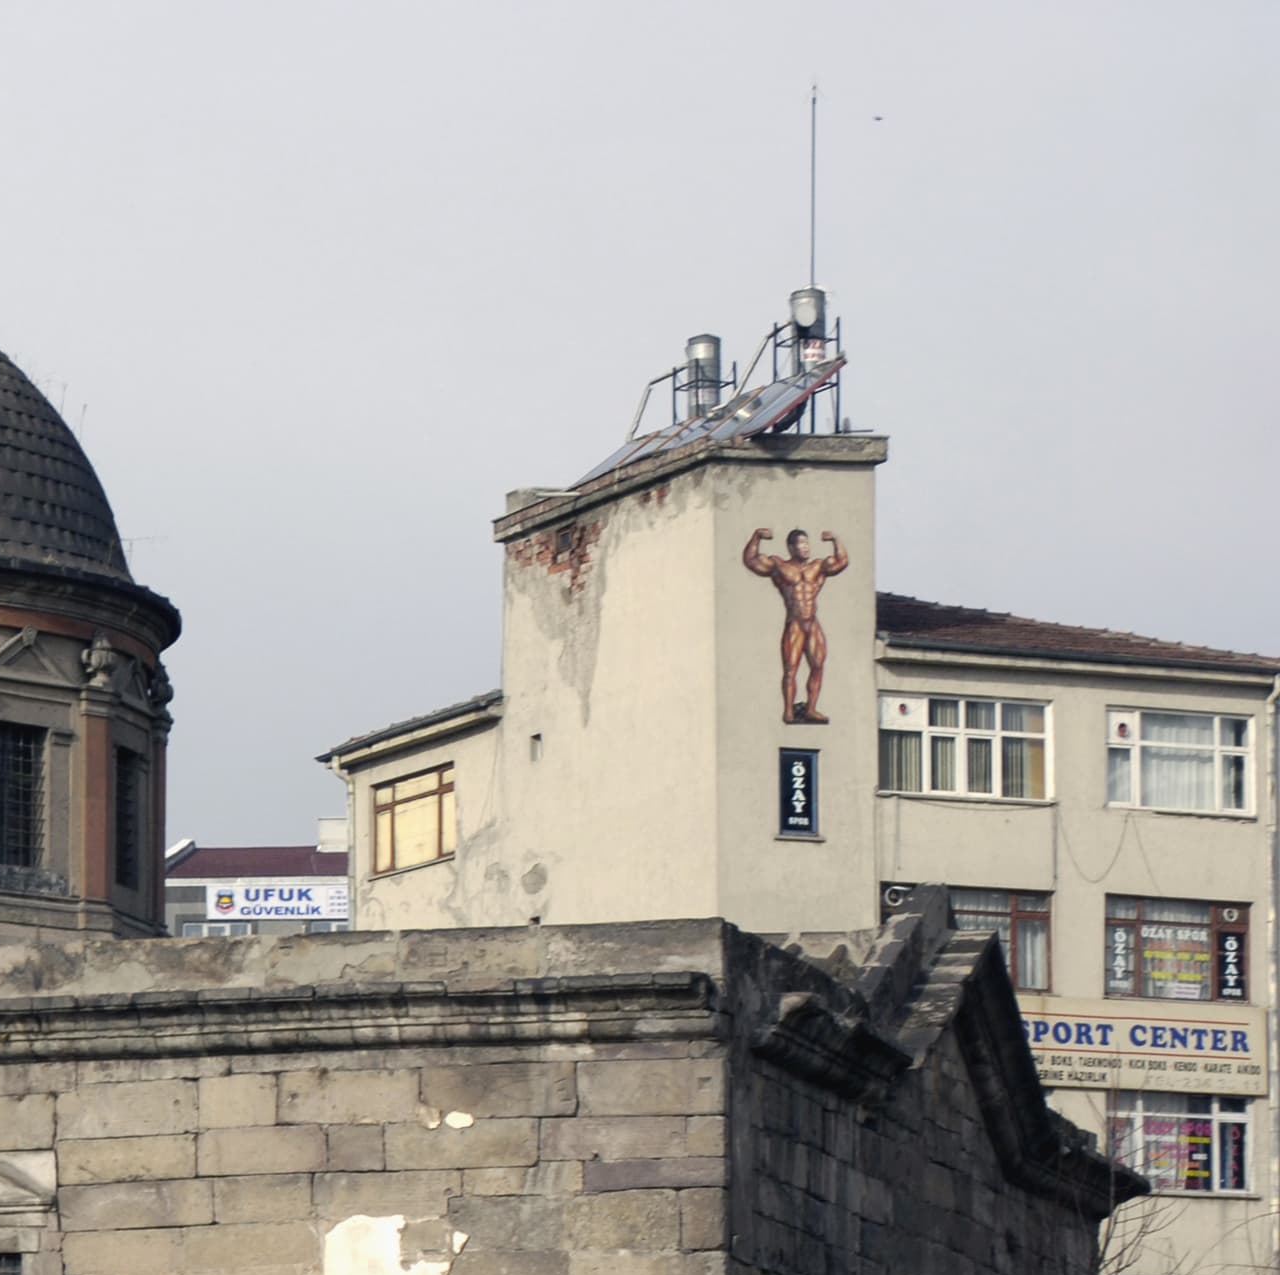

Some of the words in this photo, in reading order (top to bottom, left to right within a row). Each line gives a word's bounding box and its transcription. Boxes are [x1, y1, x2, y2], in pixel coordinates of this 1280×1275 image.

[791, 761, 807, 813] ÖZAY
[244, 887, 313, 902] UFUK
[239, 904, 321, 916] GÜVENLİK
[1224, 936, 1239, 987] ÖZAY
[1129, 1025, 1250, 1053] CENTER
